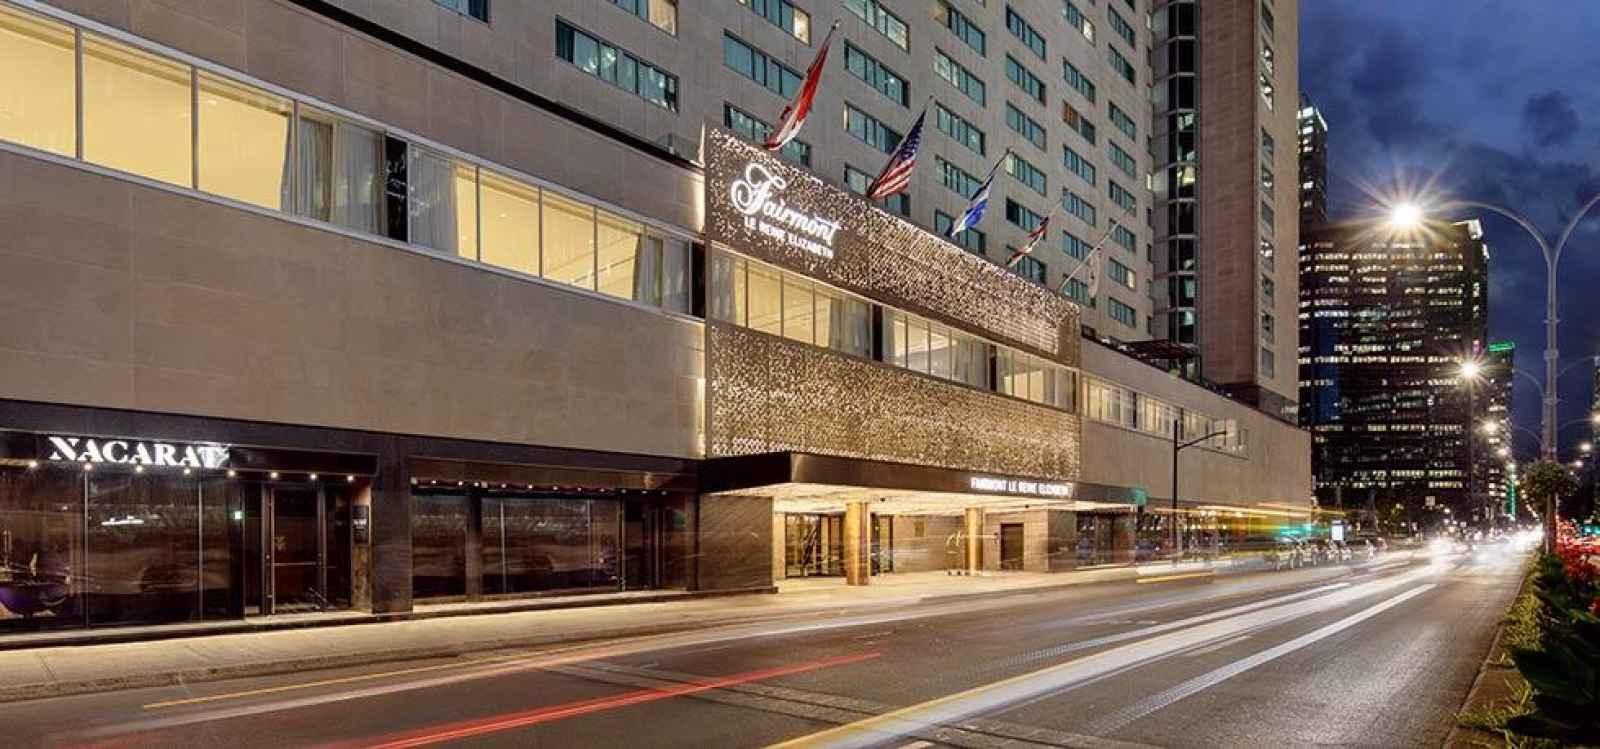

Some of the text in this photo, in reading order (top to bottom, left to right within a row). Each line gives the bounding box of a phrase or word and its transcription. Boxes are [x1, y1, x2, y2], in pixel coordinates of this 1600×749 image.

[731, 163, 839, 246] Fairmont
[744, 216, 757, 231] LE
[49, 437, 228, 468] NACARAT
[1009, 480, 1018, 492] LE
